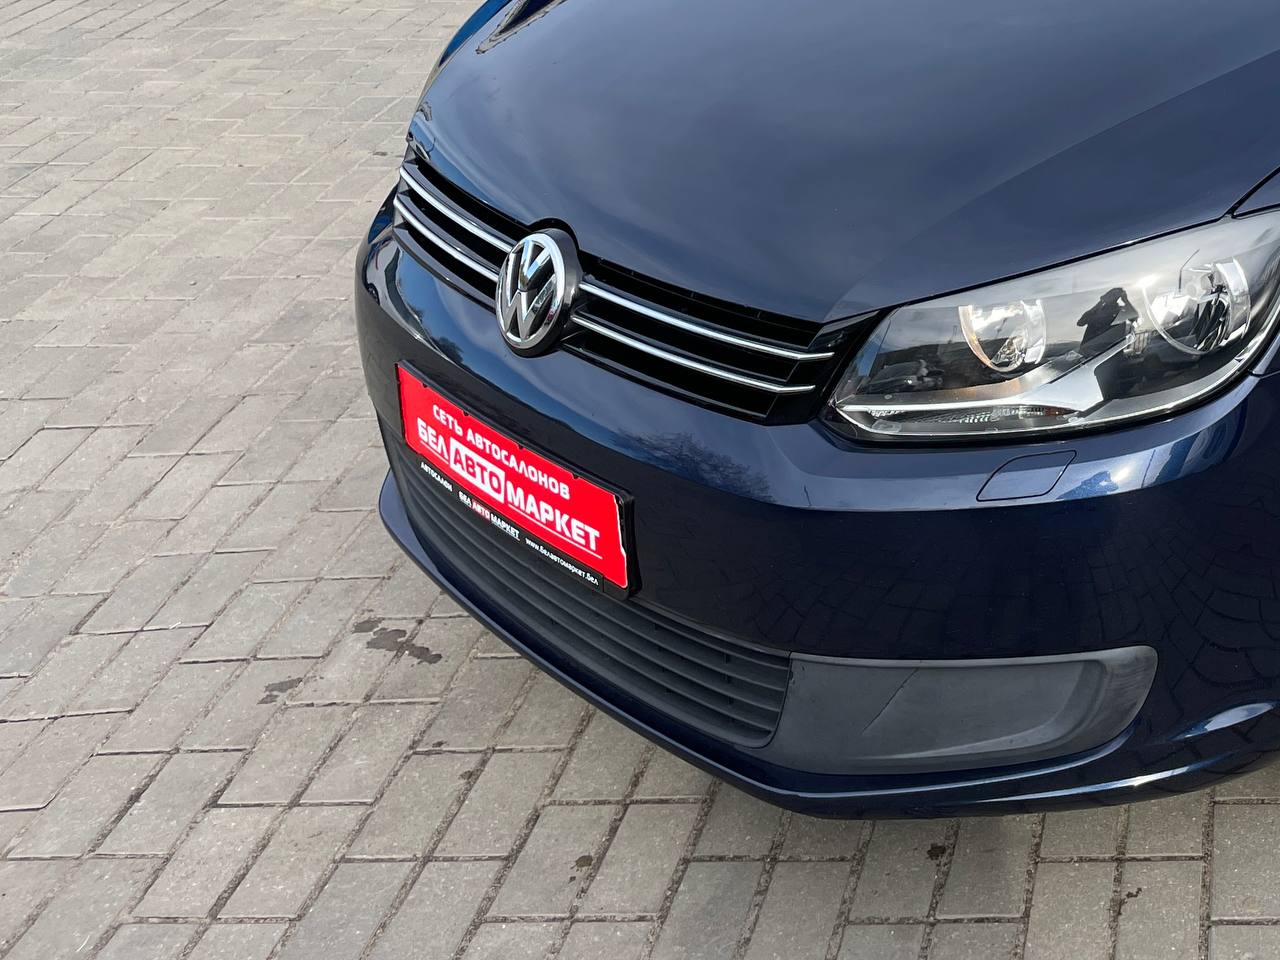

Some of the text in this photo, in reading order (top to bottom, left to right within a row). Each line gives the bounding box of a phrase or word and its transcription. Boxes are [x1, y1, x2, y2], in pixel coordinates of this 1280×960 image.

[417, 416, 600, 551] БЕЛ АВТО МАРКЕТ
[432, 404, 570, 500] СЕТЬ АВТОСАЛОНОВ
